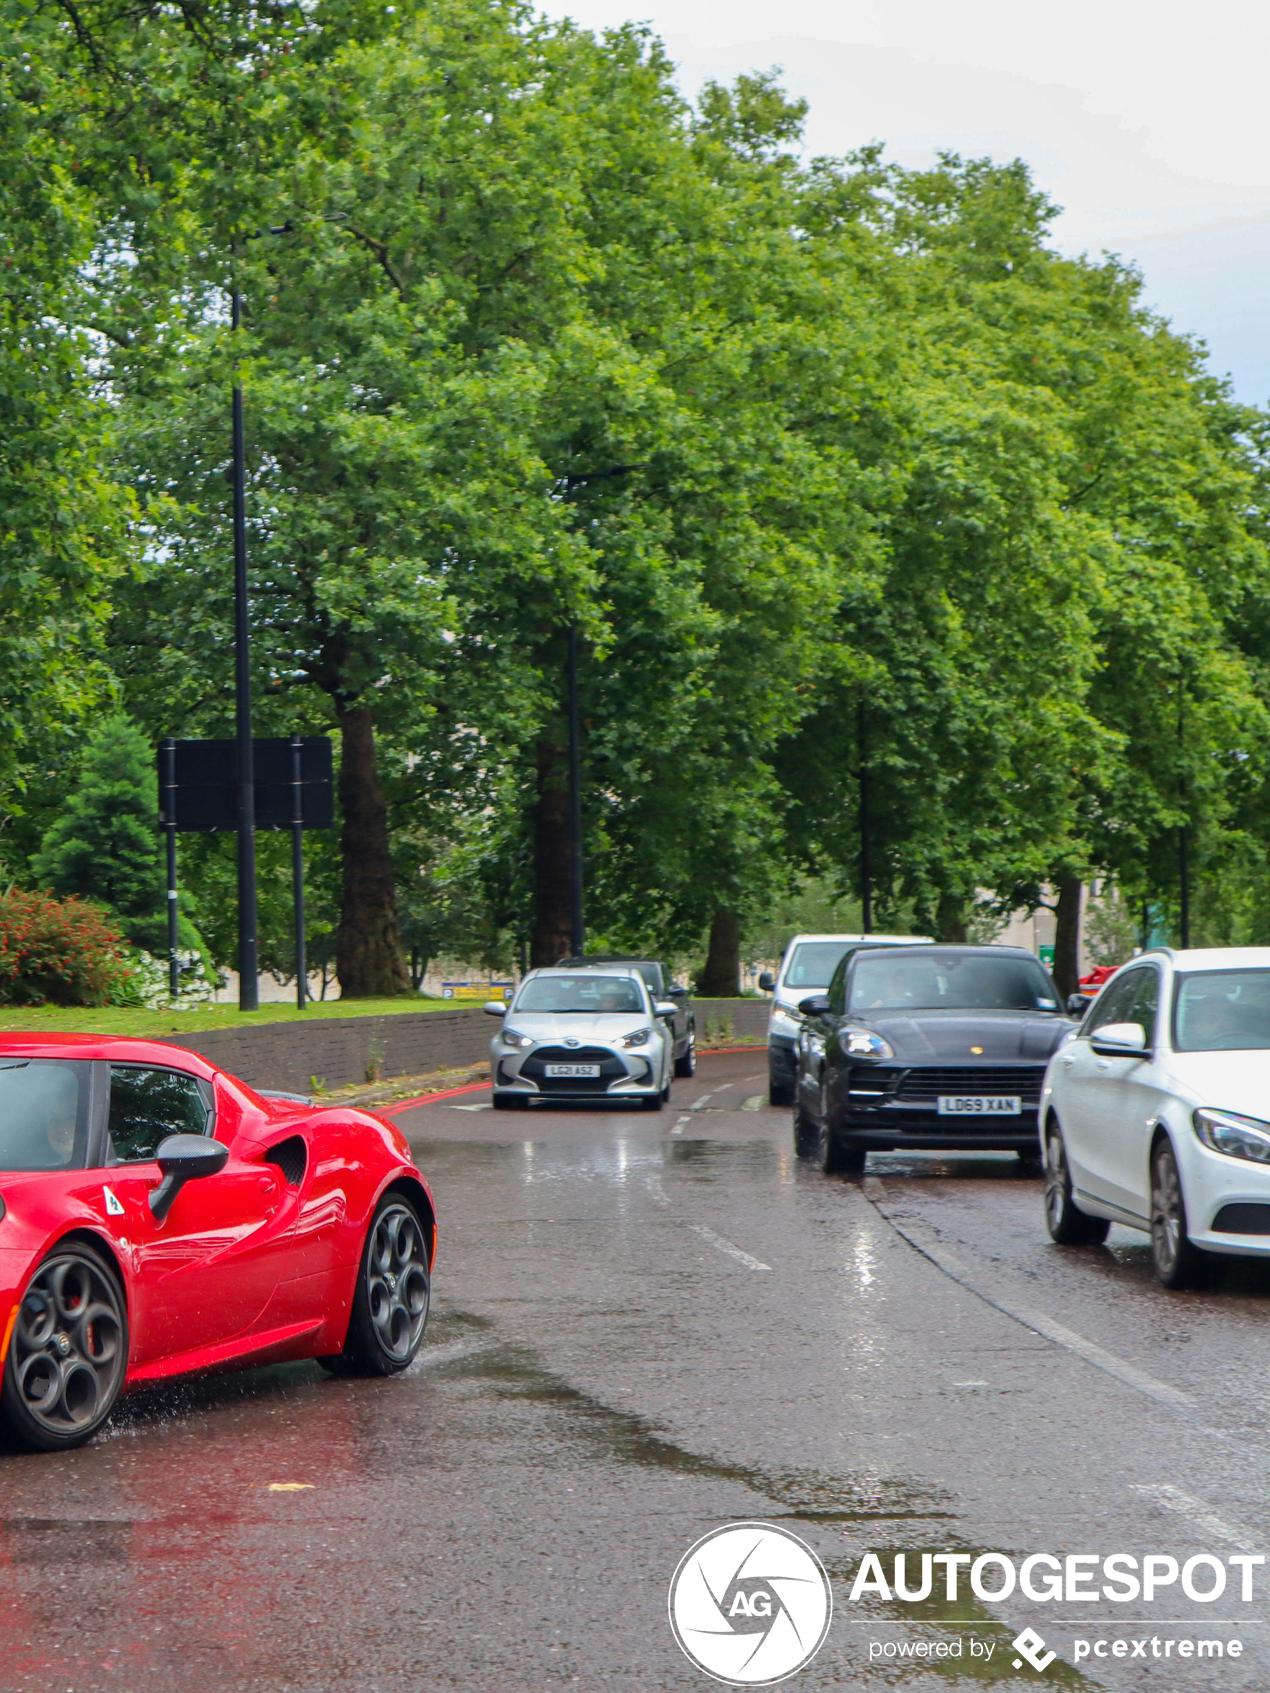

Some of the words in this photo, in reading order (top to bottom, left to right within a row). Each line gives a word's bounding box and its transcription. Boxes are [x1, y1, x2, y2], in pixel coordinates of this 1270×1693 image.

[550, 1066, 572, 1075] LG21
[574, 1066, 594, 1075] ASZ
[945, 1098, 982, 1111] LD69
[986, 1098, 1014, 1111] XAN
